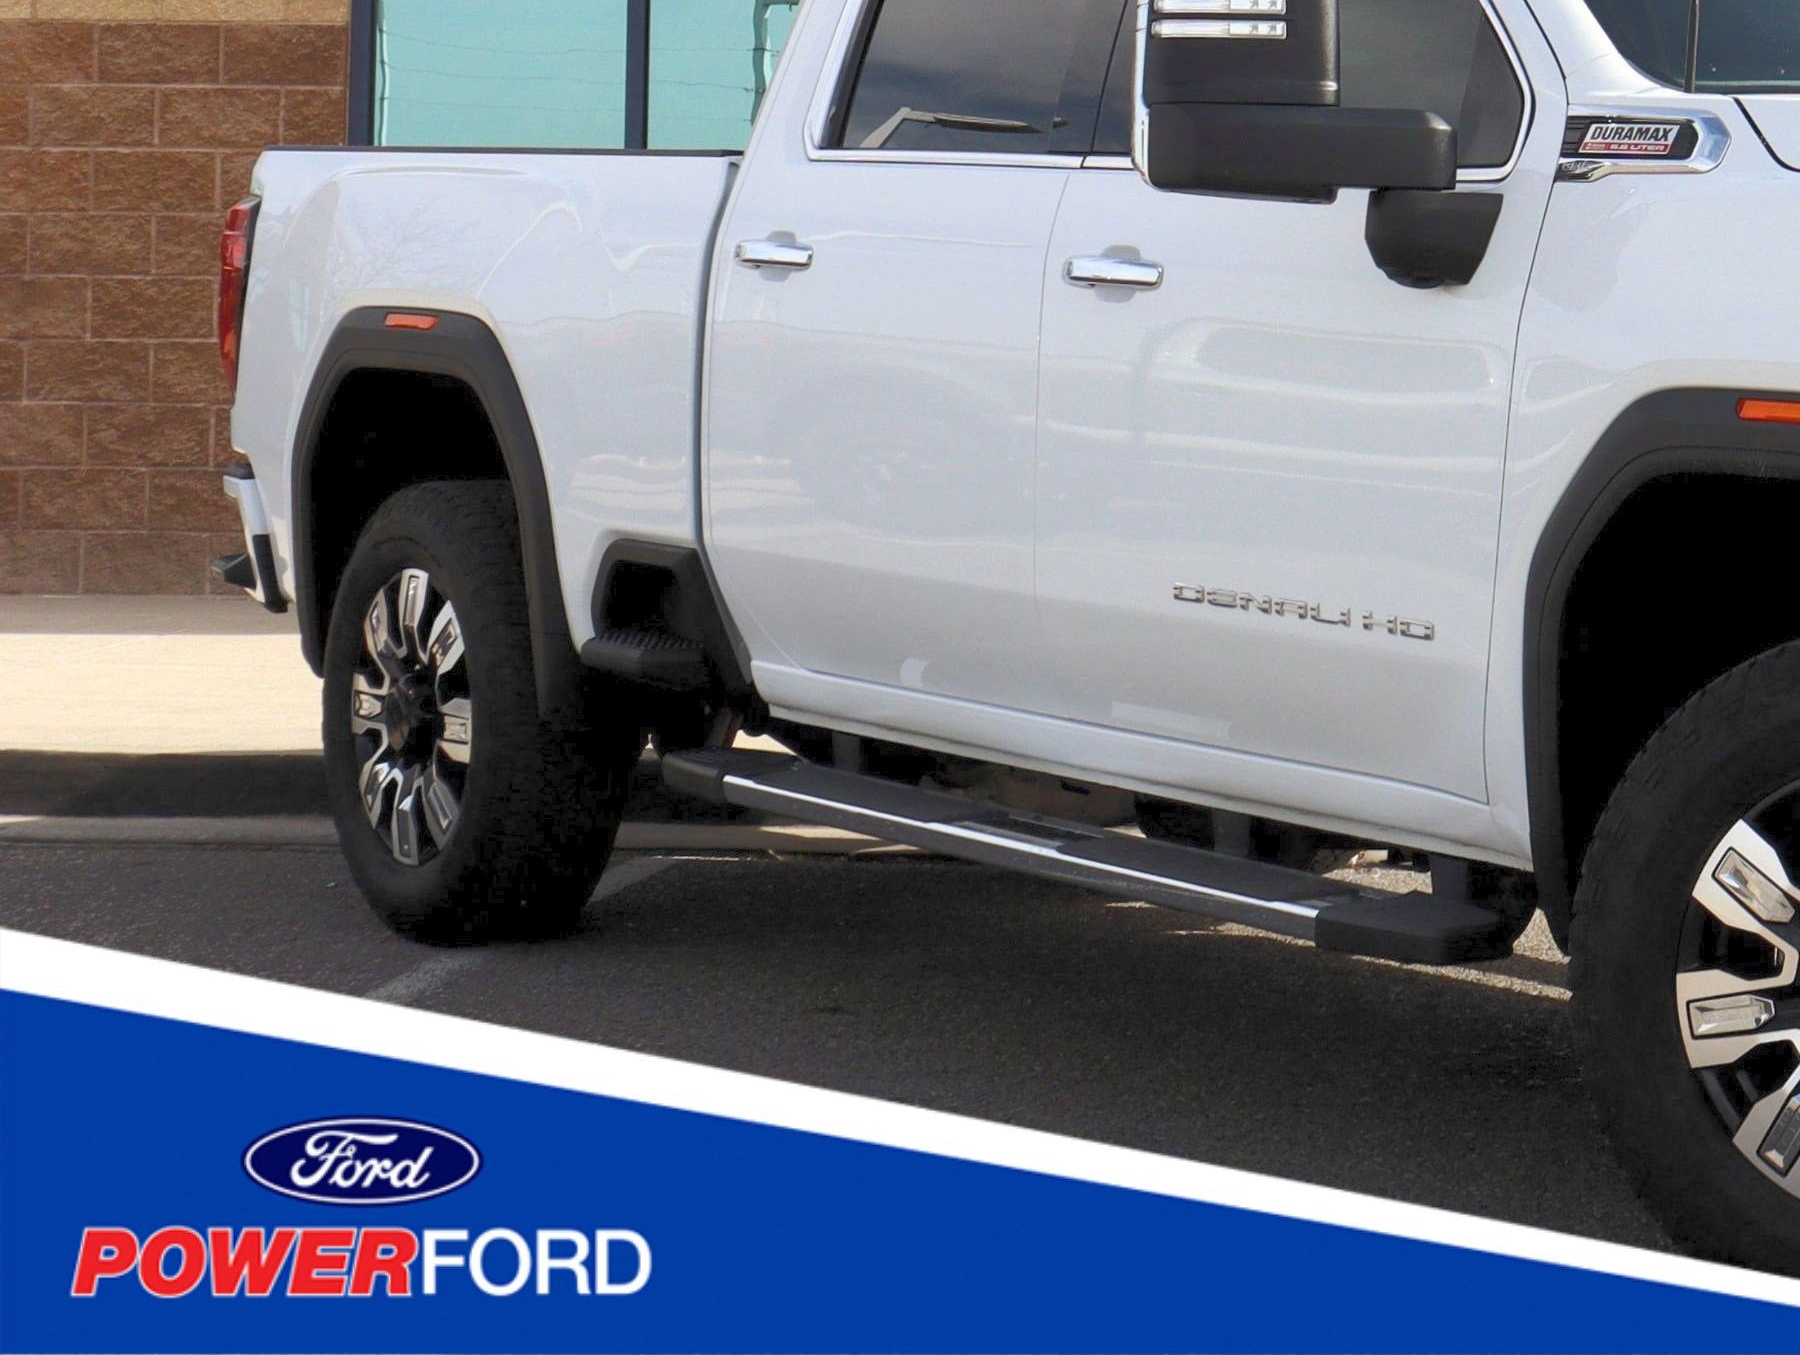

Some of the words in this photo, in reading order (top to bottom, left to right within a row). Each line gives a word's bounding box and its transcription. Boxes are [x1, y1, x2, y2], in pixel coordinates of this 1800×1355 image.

[1591, 126, 1673, 142] DURAMAX
[1172, 582, 1351, 627] DENALI
[1362, 611, 1435, 641] HD
